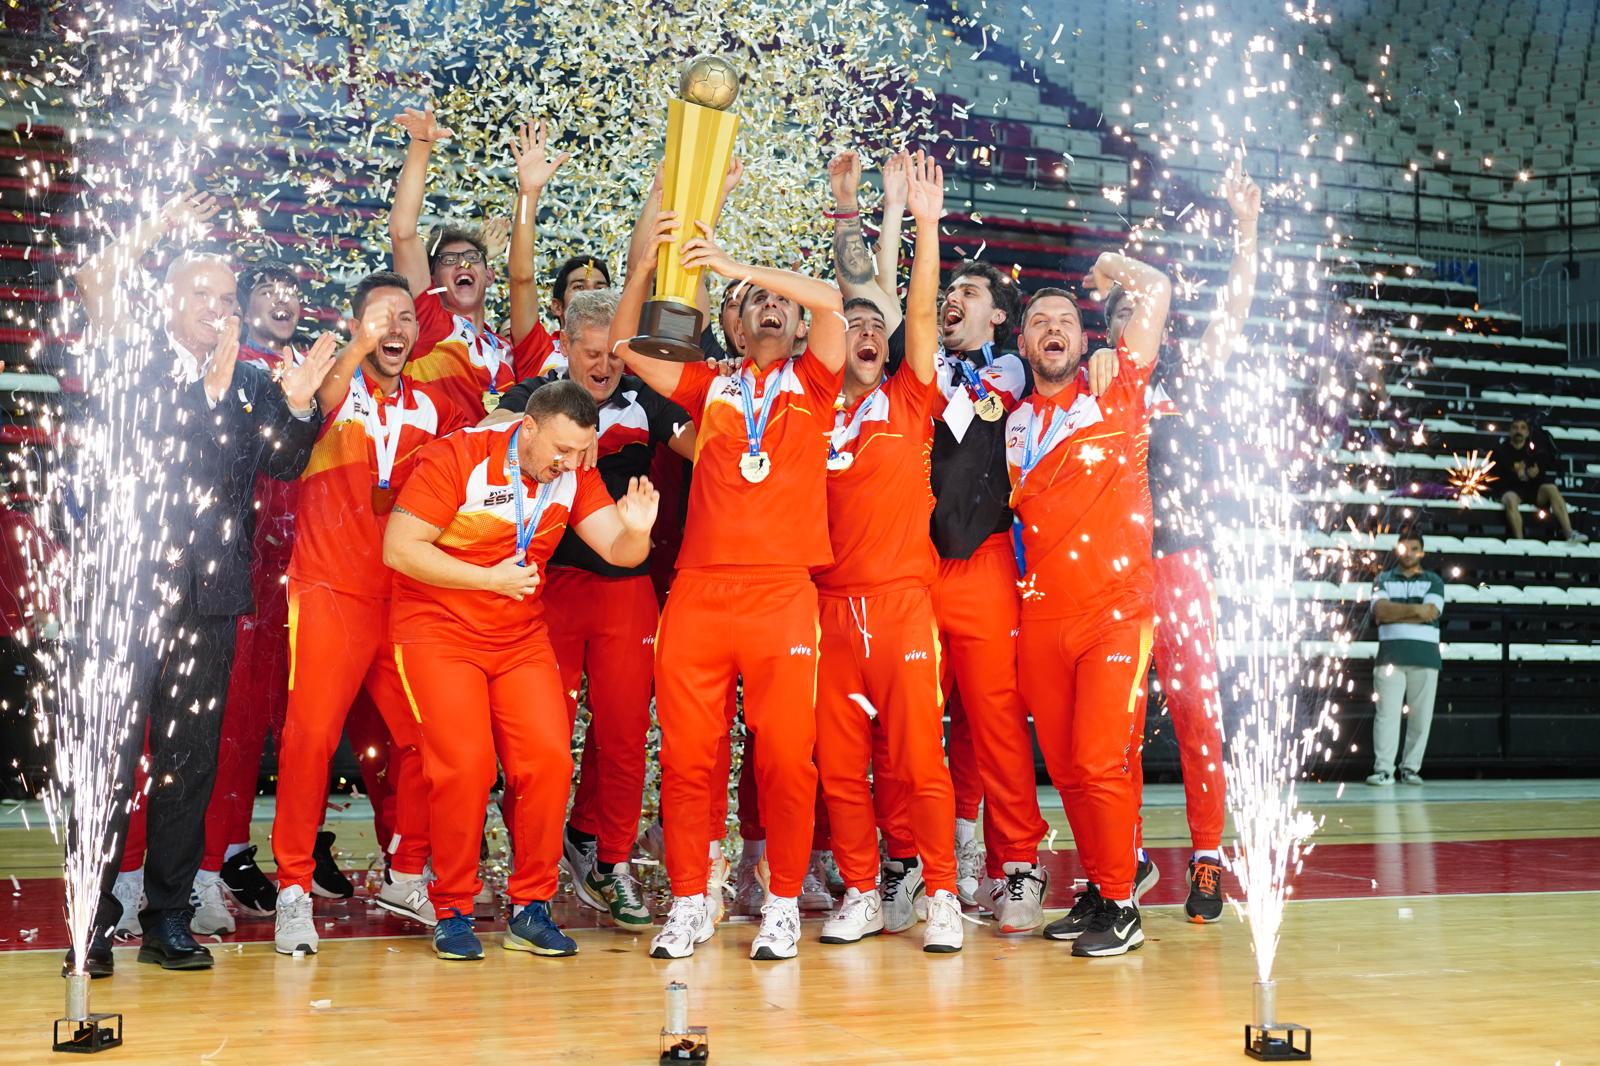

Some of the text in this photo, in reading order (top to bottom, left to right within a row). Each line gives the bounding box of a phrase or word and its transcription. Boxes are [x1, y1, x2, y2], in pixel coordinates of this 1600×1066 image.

[483, 493, 515, 507] ESP
[642, 634, 656, 645] viv
[790, 643, 812, 656] vive
[904, 649, 928, 662] vive
[1106, 652, 1133, 664] vive
